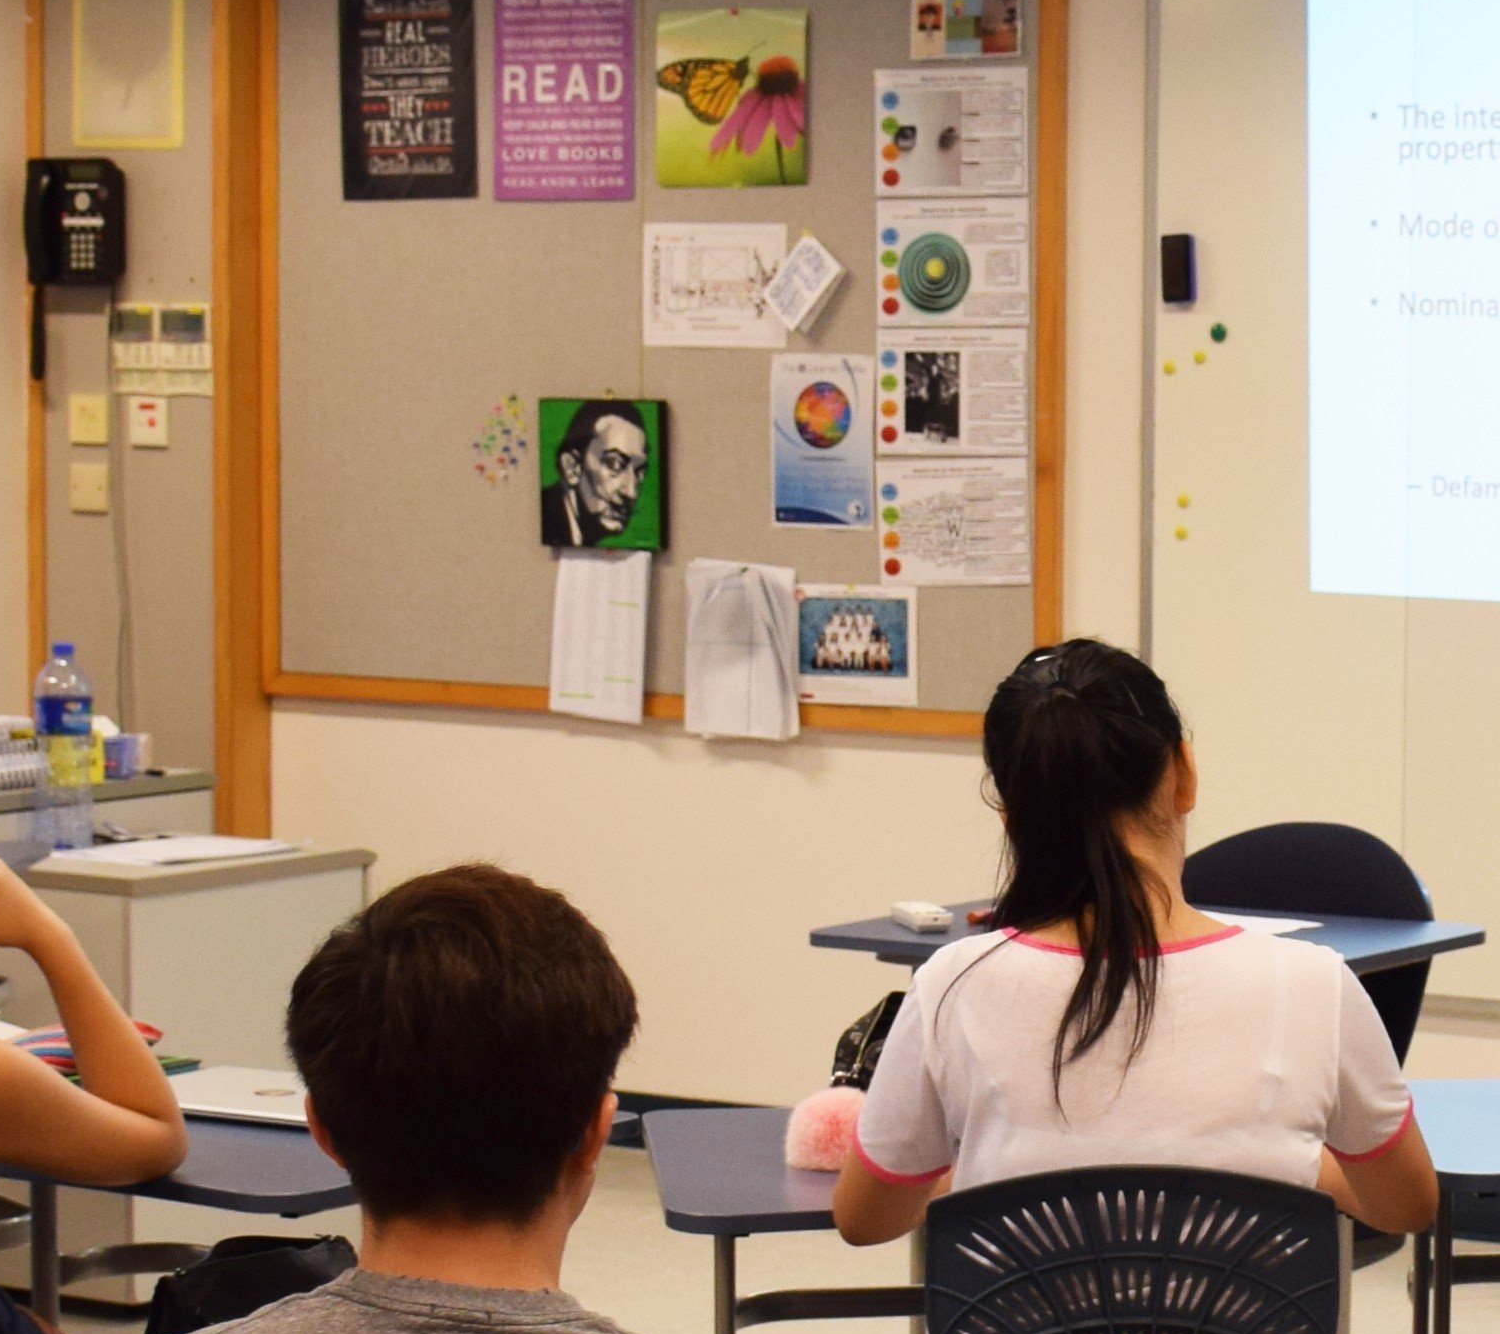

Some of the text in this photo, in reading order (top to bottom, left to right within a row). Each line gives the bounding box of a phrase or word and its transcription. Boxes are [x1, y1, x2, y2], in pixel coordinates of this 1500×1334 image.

[384, 20, 426, 43] REAL
[362, 45, 451, 67] HEROES
[502, 63, 624, 104] READ
[1399, 104, 1445, 129] The
[363, 119, 454, 146] TEACH
[502, 145, 624, 162] LOVE BOOKS
[1399, 212, 1475, 239] Mode
